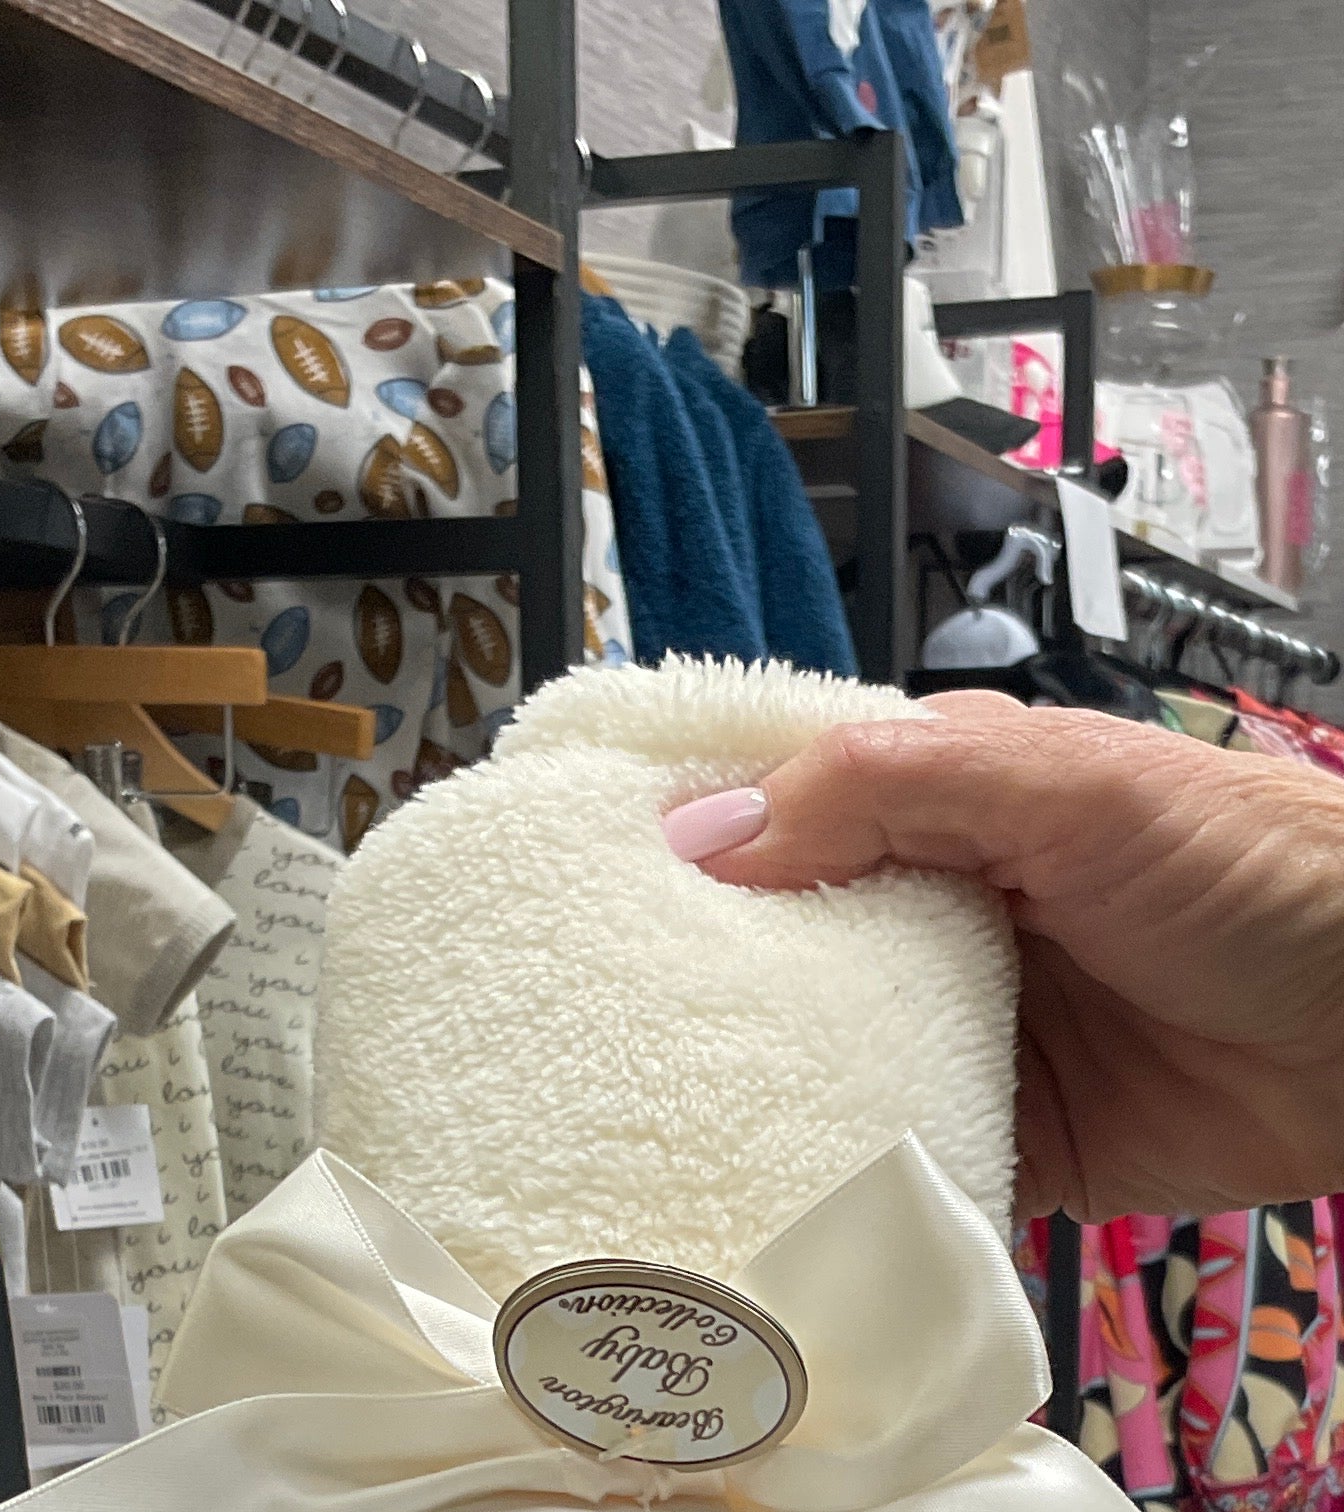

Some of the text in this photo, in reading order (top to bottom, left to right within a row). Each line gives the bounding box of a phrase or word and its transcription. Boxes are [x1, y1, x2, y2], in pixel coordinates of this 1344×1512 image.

[125, 1256, 202, 1295] you
[579, 1323, 714, 1397] Baby
[539, 1375, 725, 1442] Bearington
